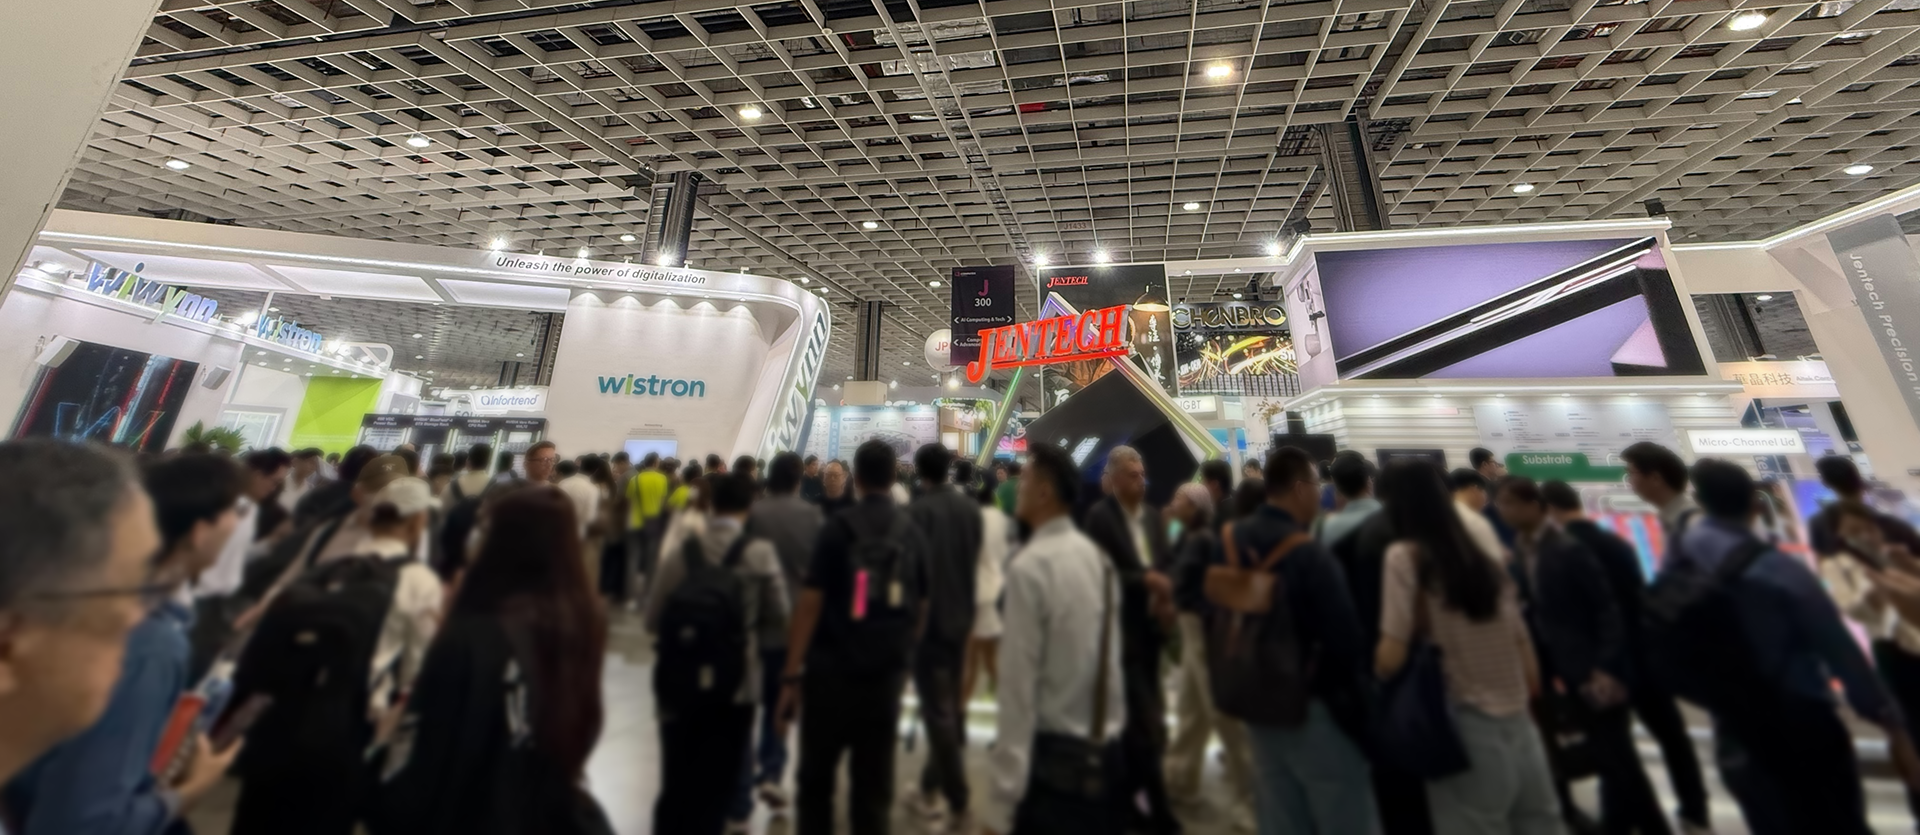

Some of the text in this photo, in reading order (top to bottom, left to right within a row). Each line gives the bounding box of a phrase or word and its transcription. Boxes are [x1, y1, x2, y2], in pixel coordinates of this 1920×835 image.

[496, 257, 706, 285] Unleash the power of digitalization
[977, 279, 989, 296] J
[1046, 276, 1088, 288] JENTECH
[86, 262, 218, 324] wiwynn
[974, 298, 991, 307] 300
[1171, 304, 1287, 329] CHENBRO
[1850, 253, 1918, 382] Jentech Precision
[257, 313, 323, 354] wistron
[966, 304, 1128, 383] JENTECH
[935, 341, 951, 351] JP
[597, 373, 706, 397] wistron
[491, 394, 540, 405] Infortrend
[1698, 437, 1796, 447] Micro-Channel Lid
[1522, 454, 1573, 465] Substrate
